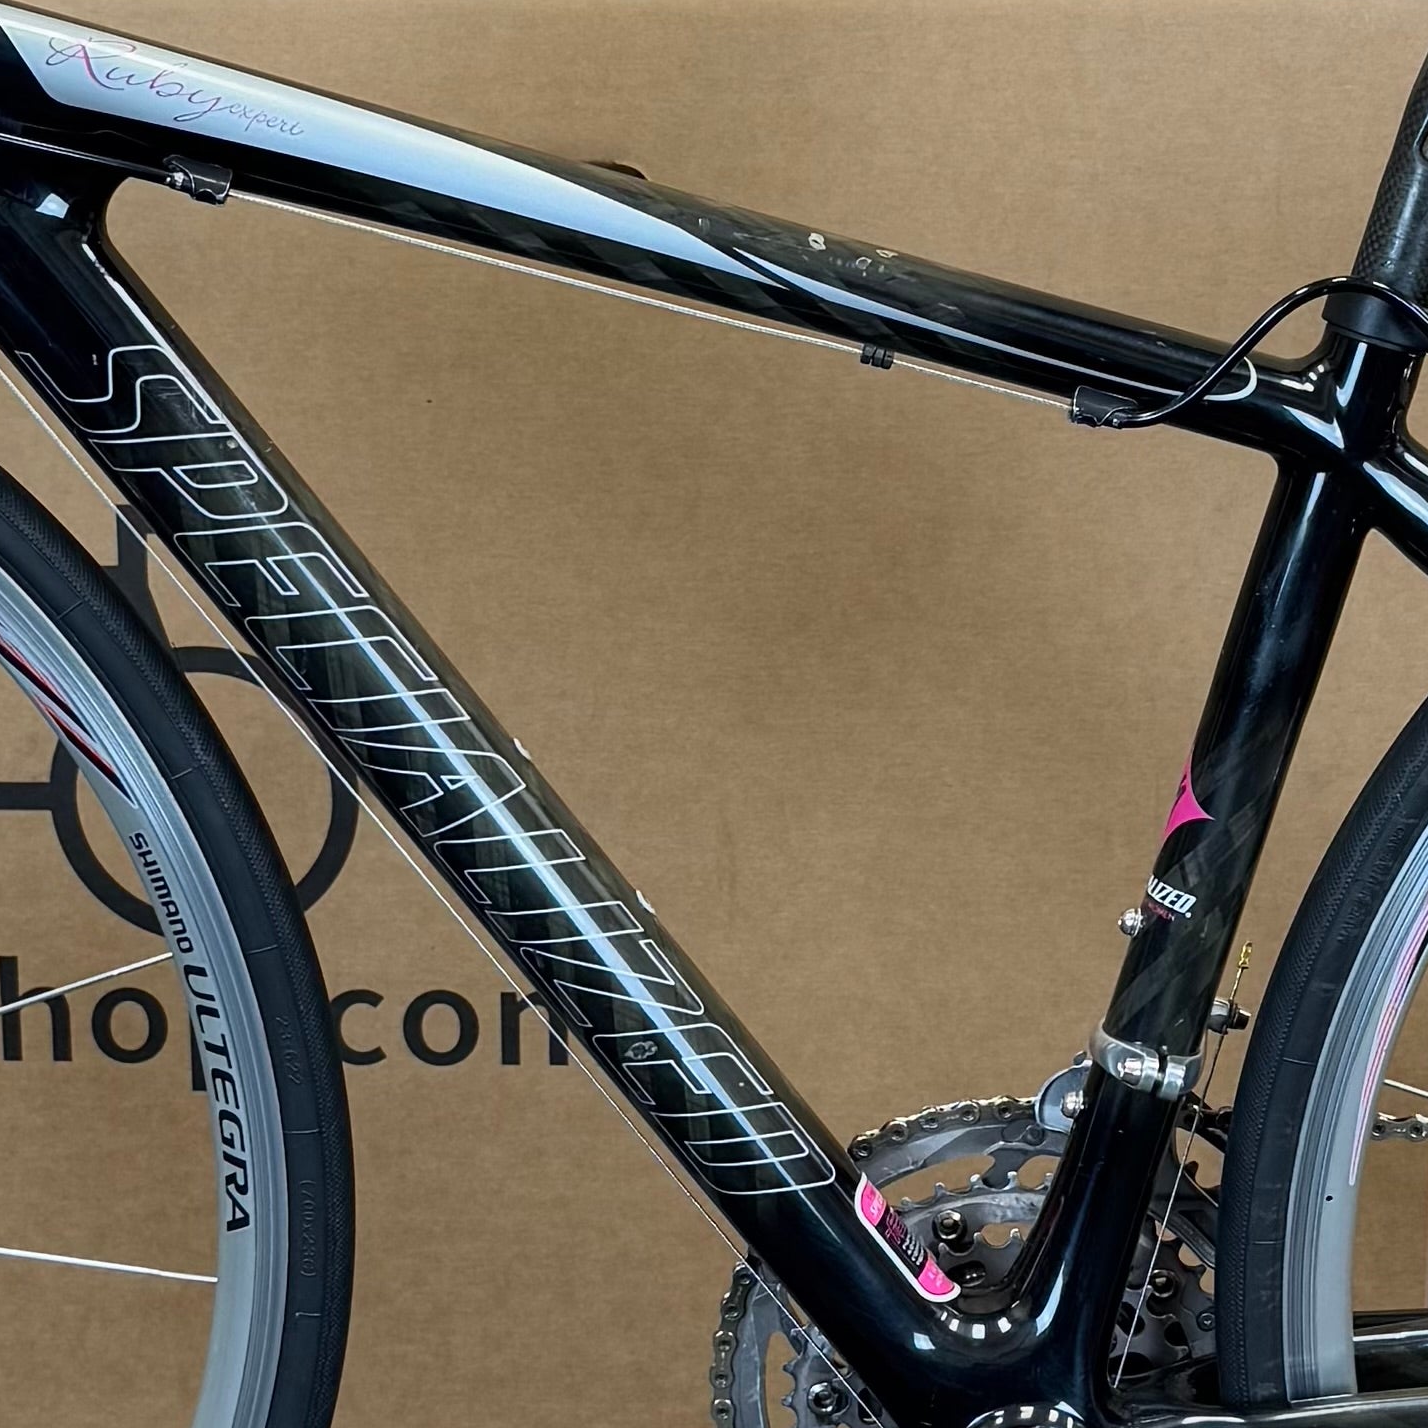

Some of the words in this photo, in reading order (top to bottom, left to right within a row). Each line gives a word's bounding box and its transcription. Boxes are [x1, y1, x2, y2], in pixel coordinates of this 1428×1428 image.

[46, 36, 229, 122] Ruby
[15, 344, 836, 1194] SPECIALIZED
[128, 831, 194, 955] SHIMANO
[183, 963, 251, 1232] ULTEGRA
